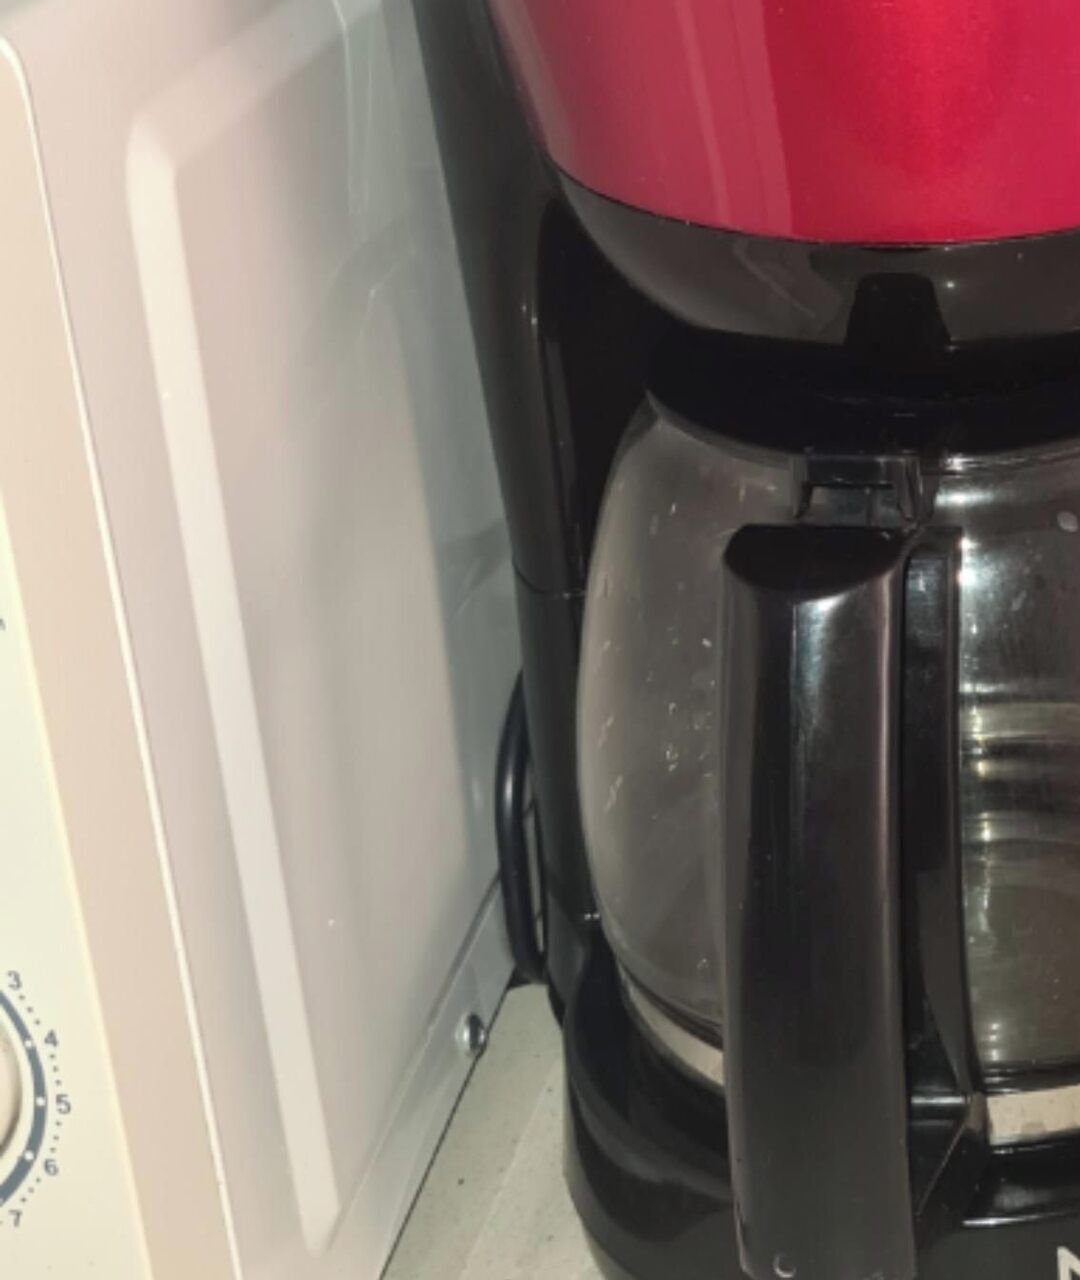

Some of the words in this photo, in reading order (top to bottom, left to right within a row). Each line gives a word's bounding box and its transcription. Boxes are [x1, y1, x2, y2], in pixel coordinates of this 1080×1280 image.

[7, 970, 22, 990] 3
[44, 1029, 59, 1048] 4
[55, 1093, 72, 1115] 5
[43, 1158, 59, 1177] 6
[8, 1208, 23, 1228] 7
